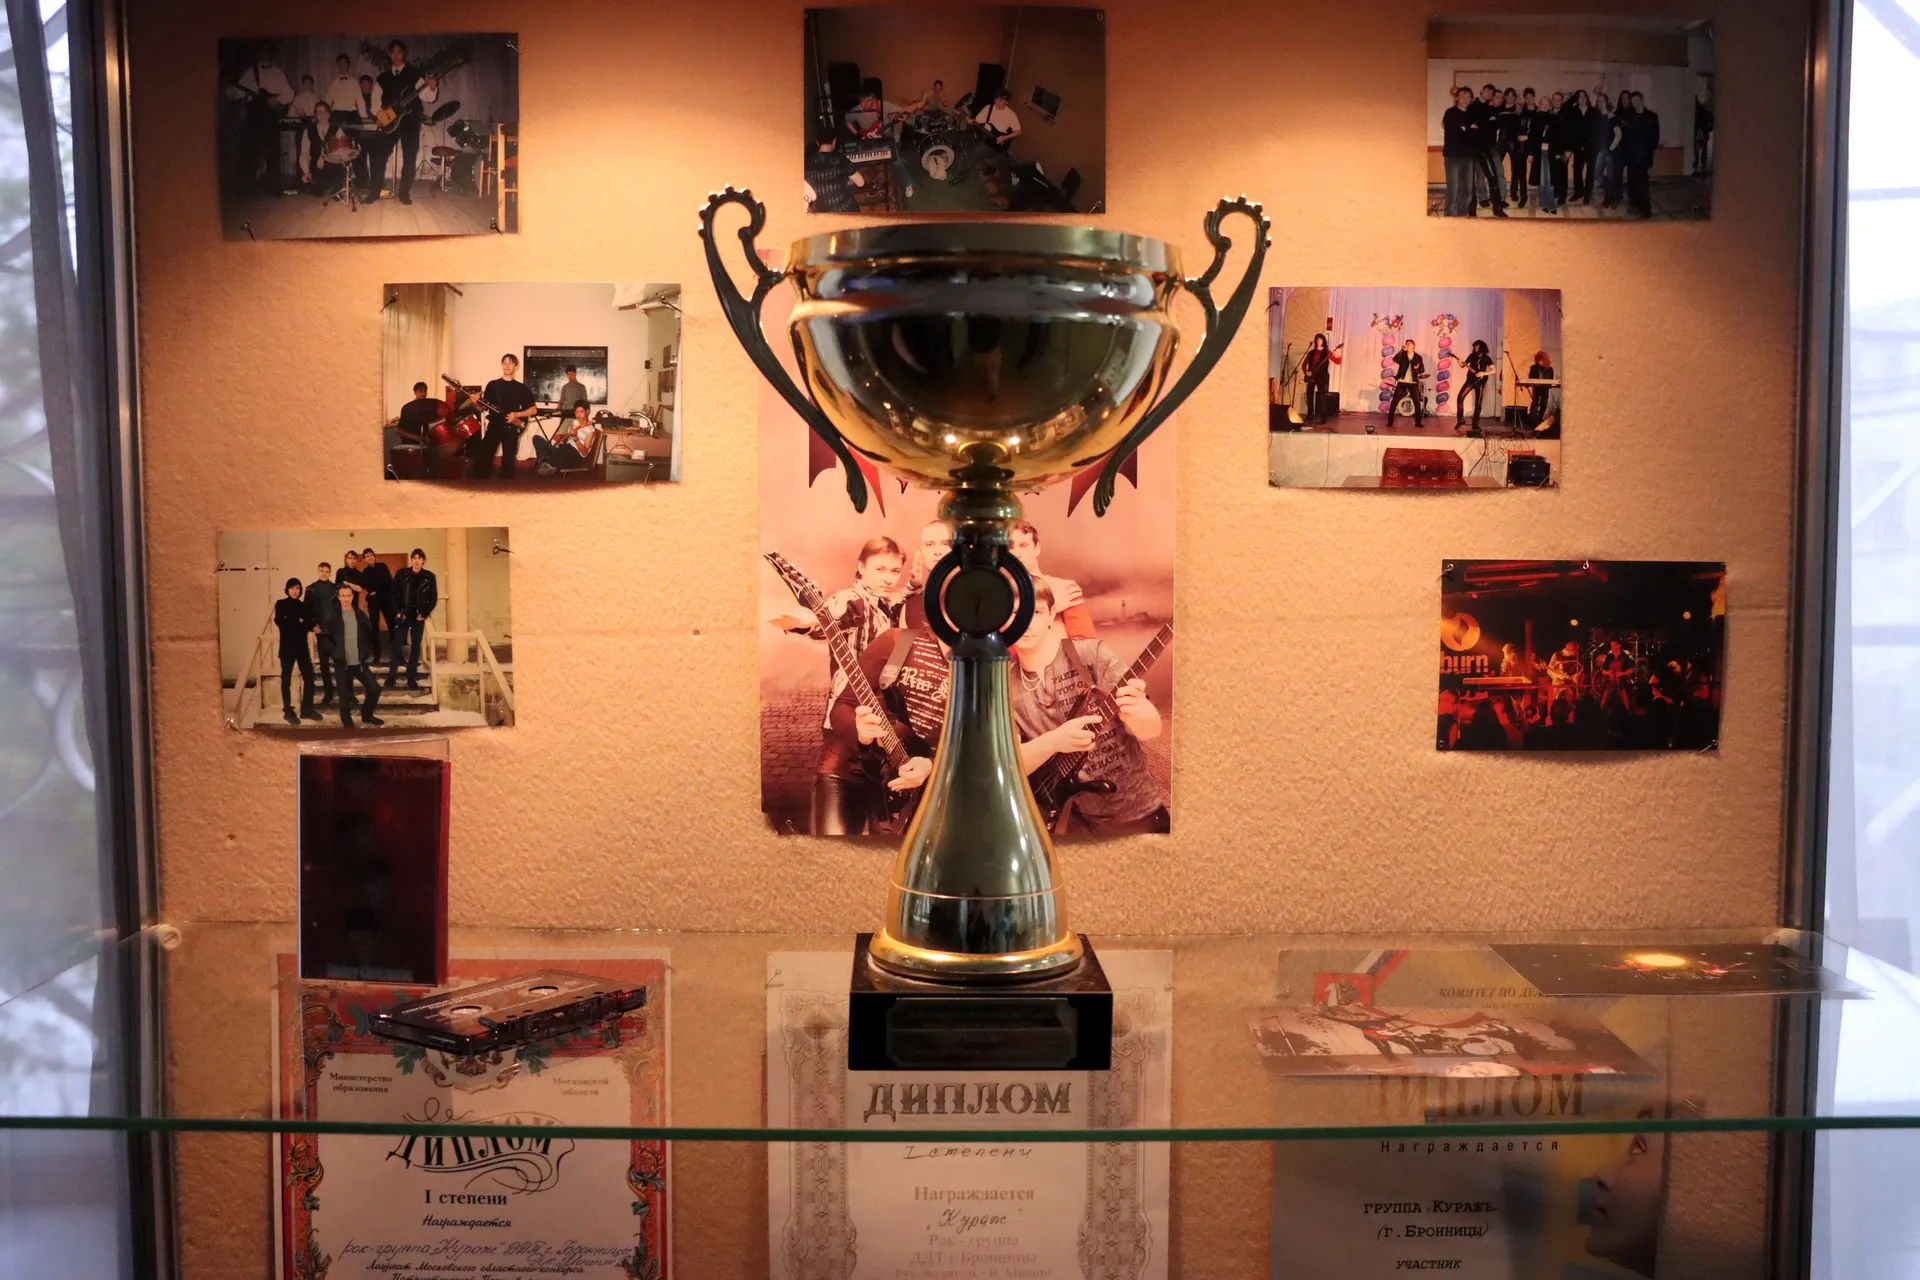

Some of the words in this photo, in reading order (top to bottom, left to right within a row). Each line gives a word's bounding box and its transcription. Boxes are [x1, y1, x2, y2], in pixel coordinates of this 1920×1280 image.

[1440, 650, 1489, 675] burn
[329, 1072, 393, 1085] Министерство
[552, 1076, 610, 1087] Московской
[332, 1083, 389, 1094] образования
[562, 1087, 600, 1097] области
[863, 1082, 1072, 1123] ДИПЛОМ
[1381, 1141, 1558, 1153] Награждается
[438, 1193, 508, 1206] степени
[914, 1186, 1035, 1204] Награждается
[1364, 1203, 1422, 1214] ГРУППА
[421, 1215, 512, 1229] Награждается
[366, 1260, 411, 1273] Лауреат
[415, 1261, 477, 1272] Московского
[1396, 1260, 1462, 1270] УЧАСТНИК
